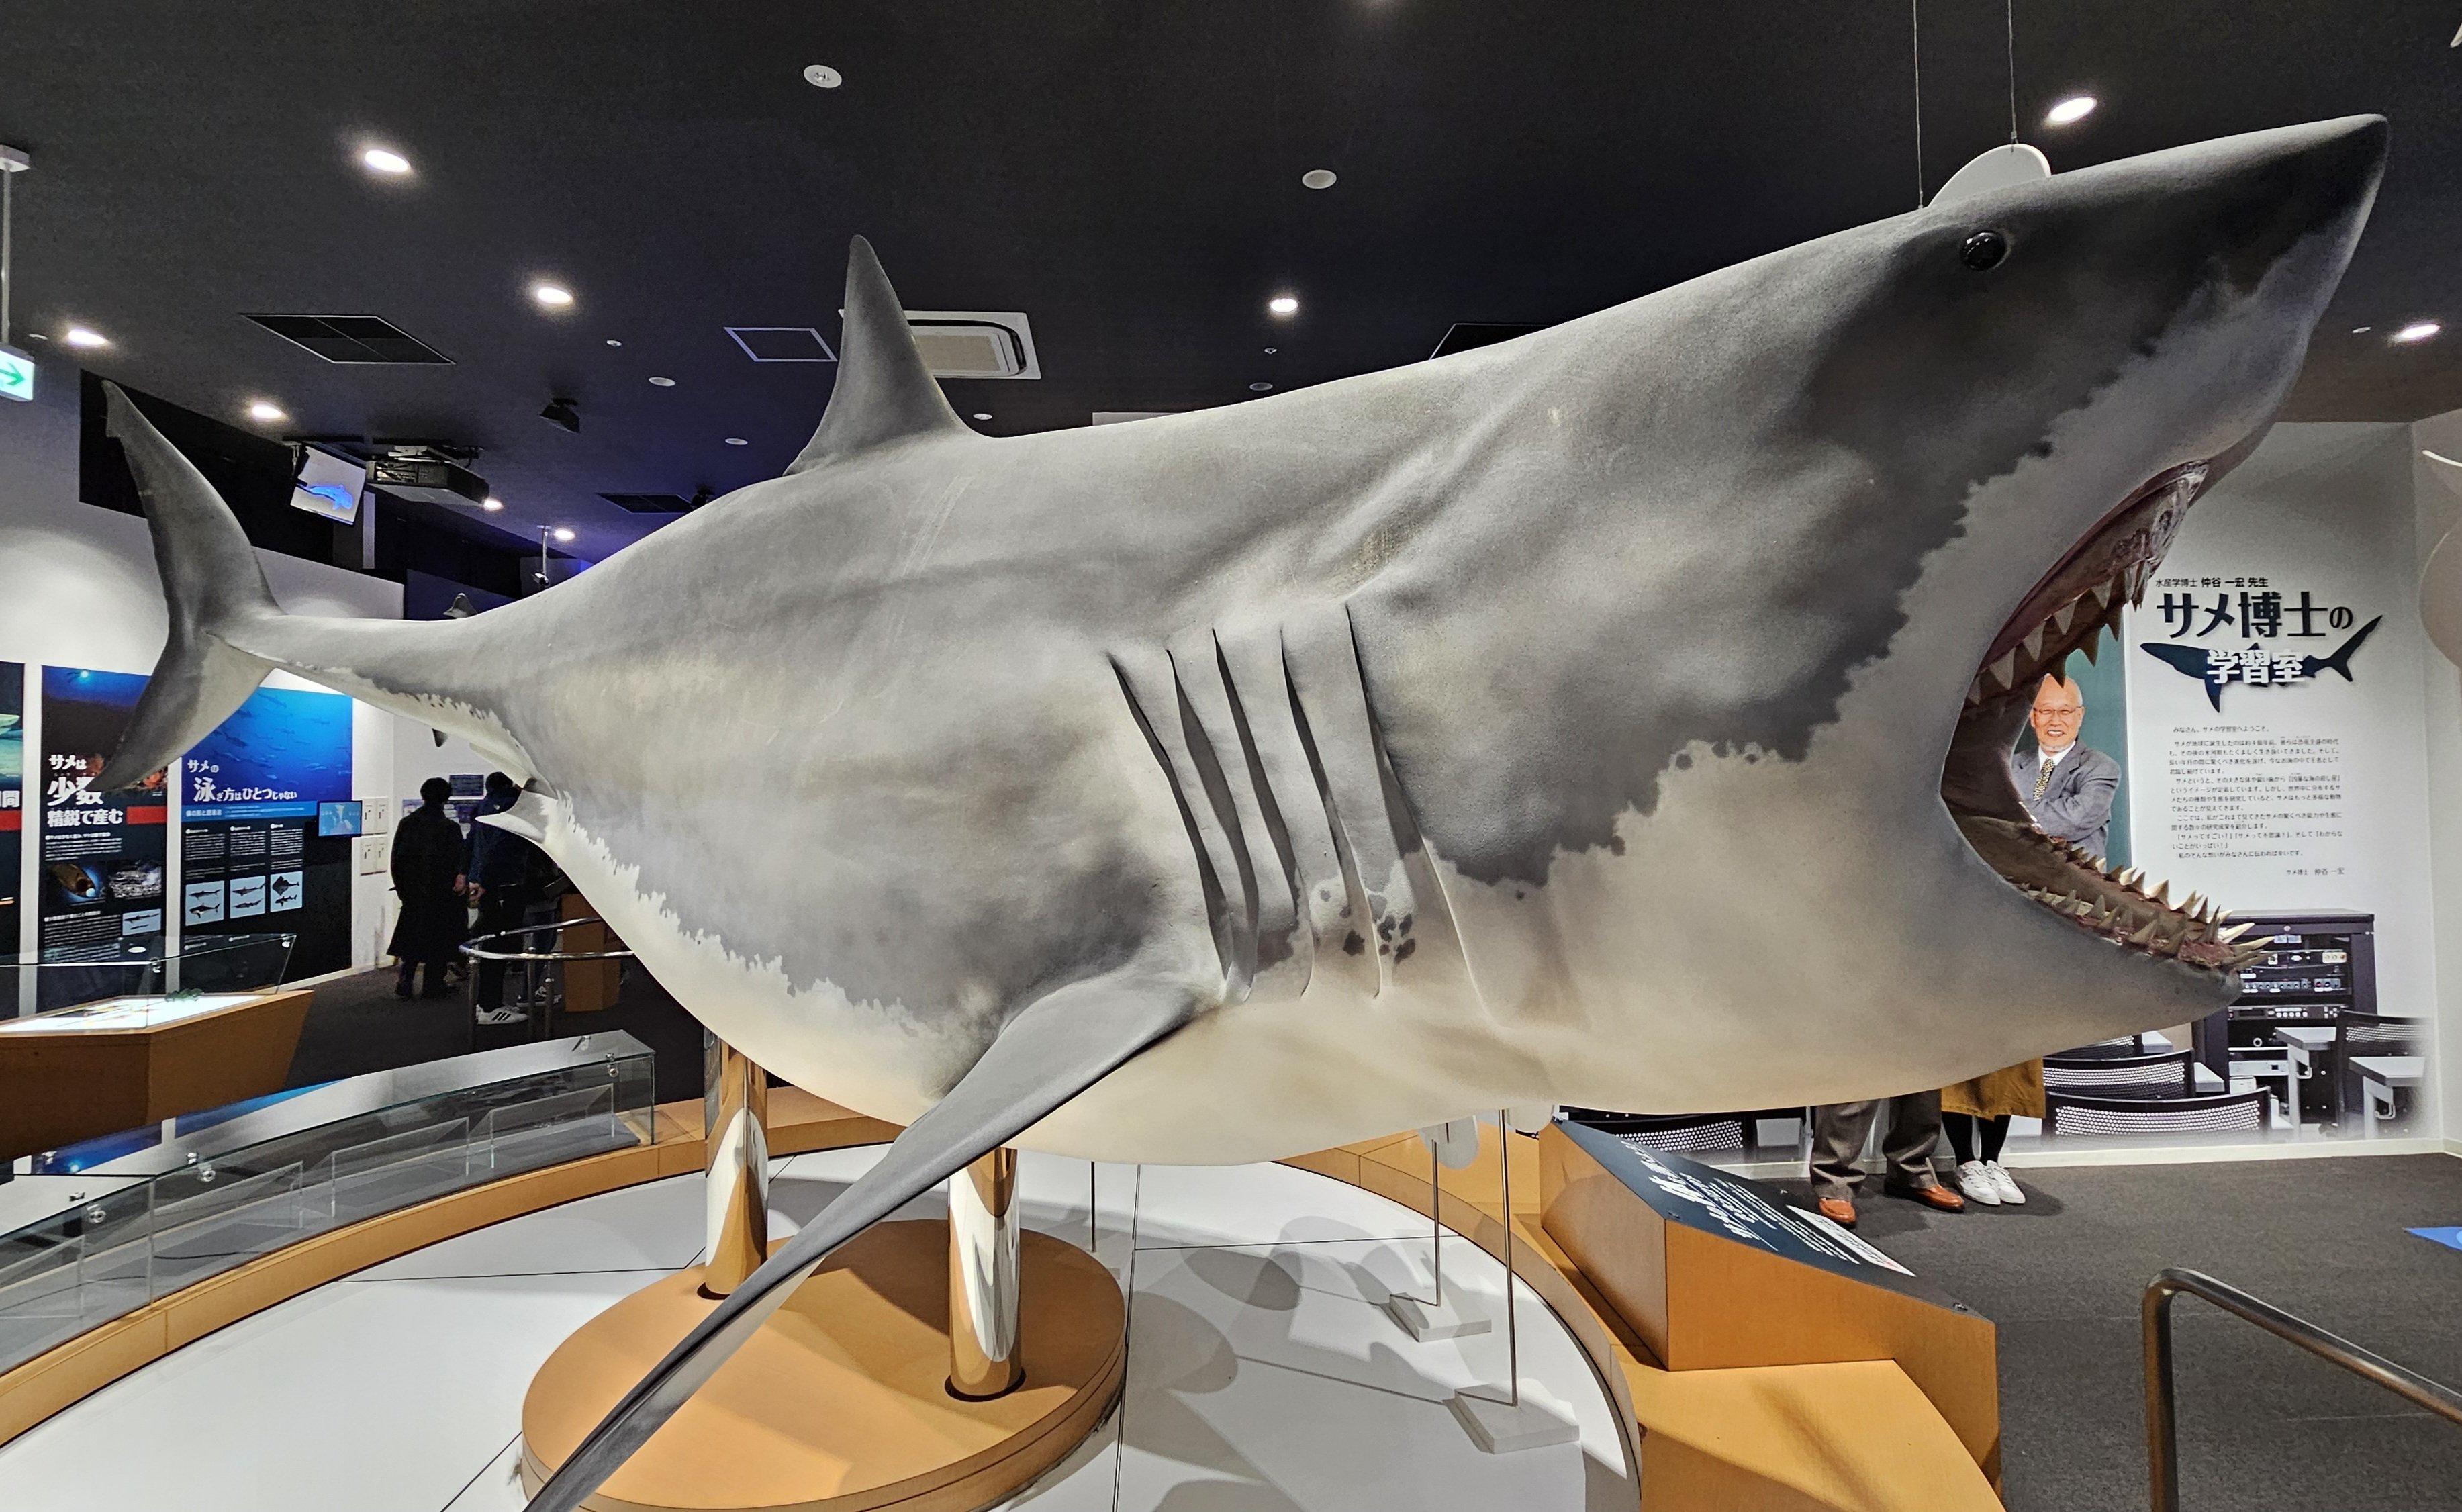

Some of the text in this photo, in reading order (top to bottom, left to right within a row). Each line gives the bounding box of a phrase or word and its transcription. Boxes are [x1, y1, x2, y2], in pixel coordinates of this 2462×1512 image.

[2155, 577, 2269, 588] 水産学博士 仲谷 一宏 先生
[2157, 590, 2353, 638] サメ博士の
[2207, 648, 2305, 684] 学習室
[48, 754, 87, 770] サメは
[187, 759, 219, 773] サメの
[193, 777, 297, 802] 泳ぎ方はひとつじゃない
[46, 808, 124, 827] 精鋭で産む
